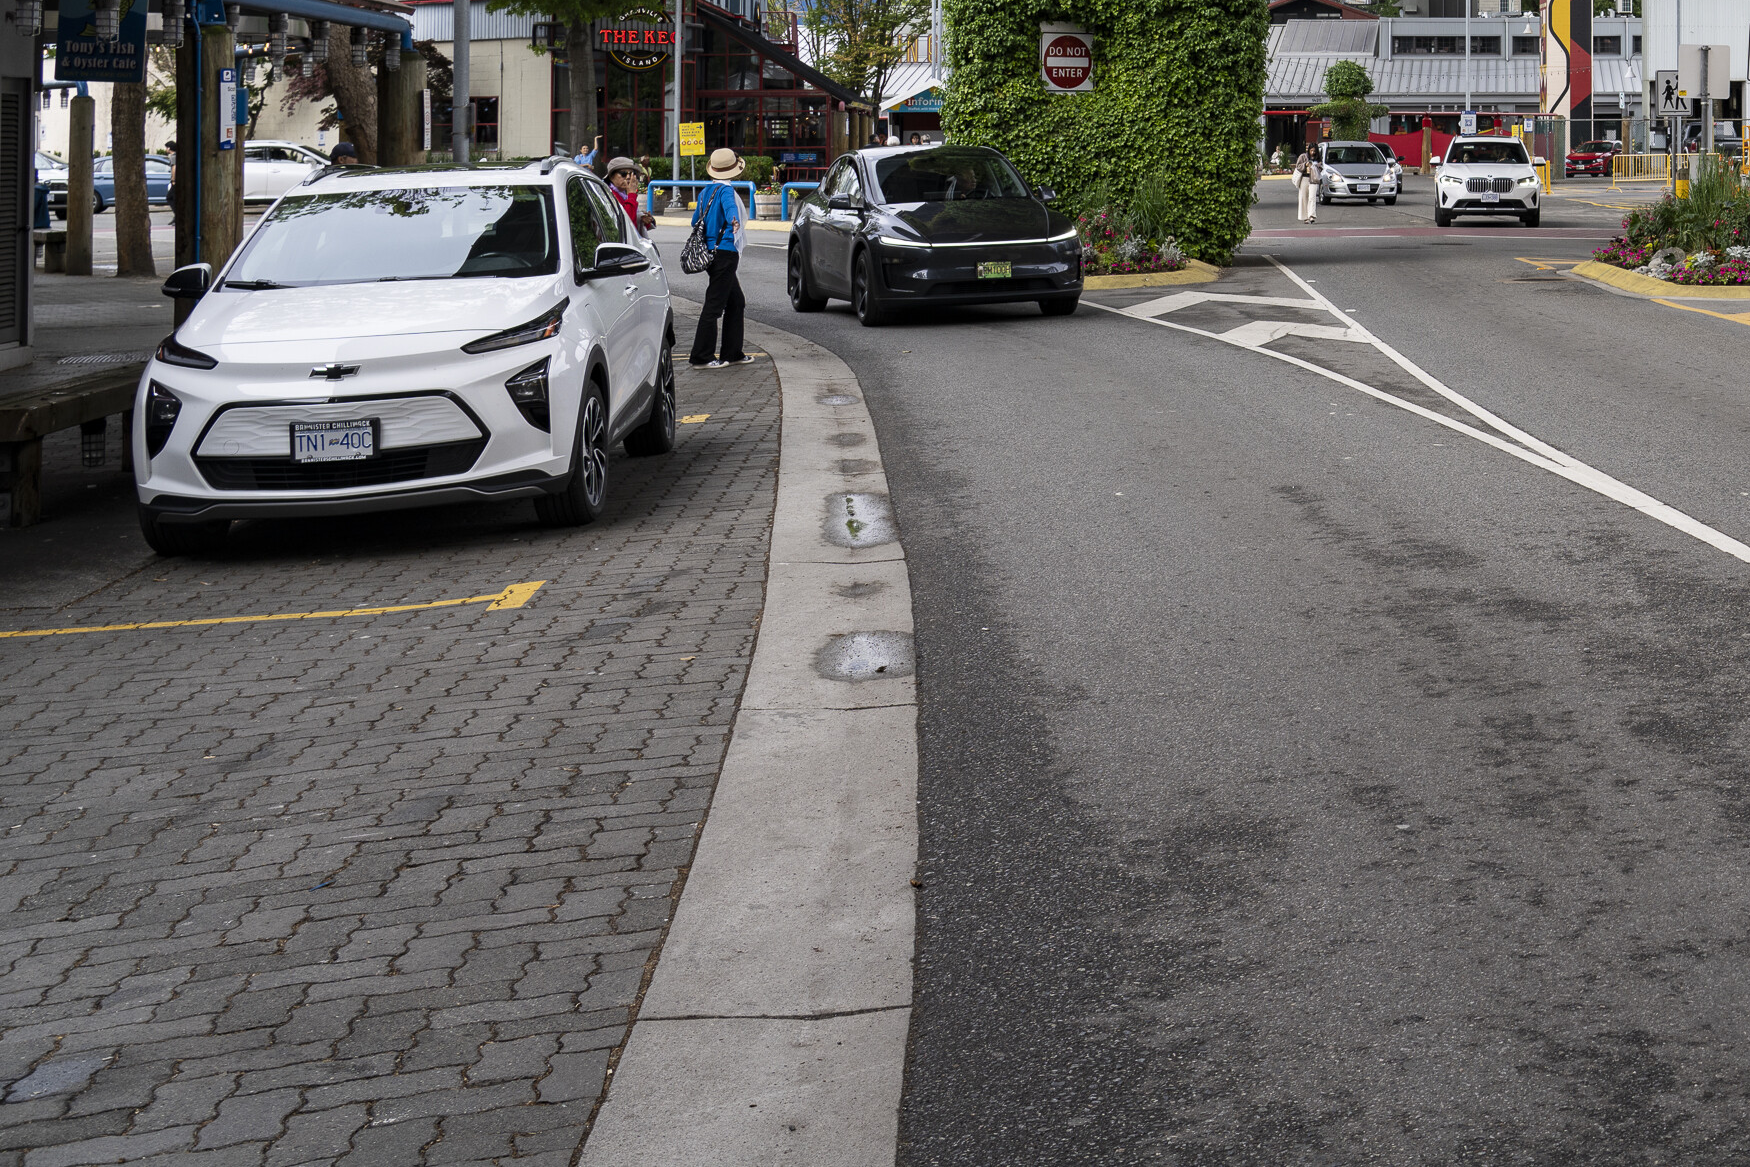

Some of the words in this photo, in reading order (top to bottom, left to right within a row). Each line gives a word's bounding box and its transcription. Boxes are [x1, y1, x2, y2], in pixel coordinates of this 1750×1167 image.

[599, 29, 640, 44] THE
[64, 40, 106, 55] Tony's
[108, 41, 136, 55] Fish
[1049, 46, 1063, 56] DO
[1066, 46, 1087, 56] NOT
[61, 56, 71, 67] &
[73, 56, 110, 70] Oyster
[112, 57, 137, 70] Cafe
[622, 55, 658, 67] ISLAND
[1052, 68, 1083, 78] ENTER
[907, 97, 943, 106] inform
[295, 422, 331, 431] BANNISTER
[295, 433, 325, 452] TN1
